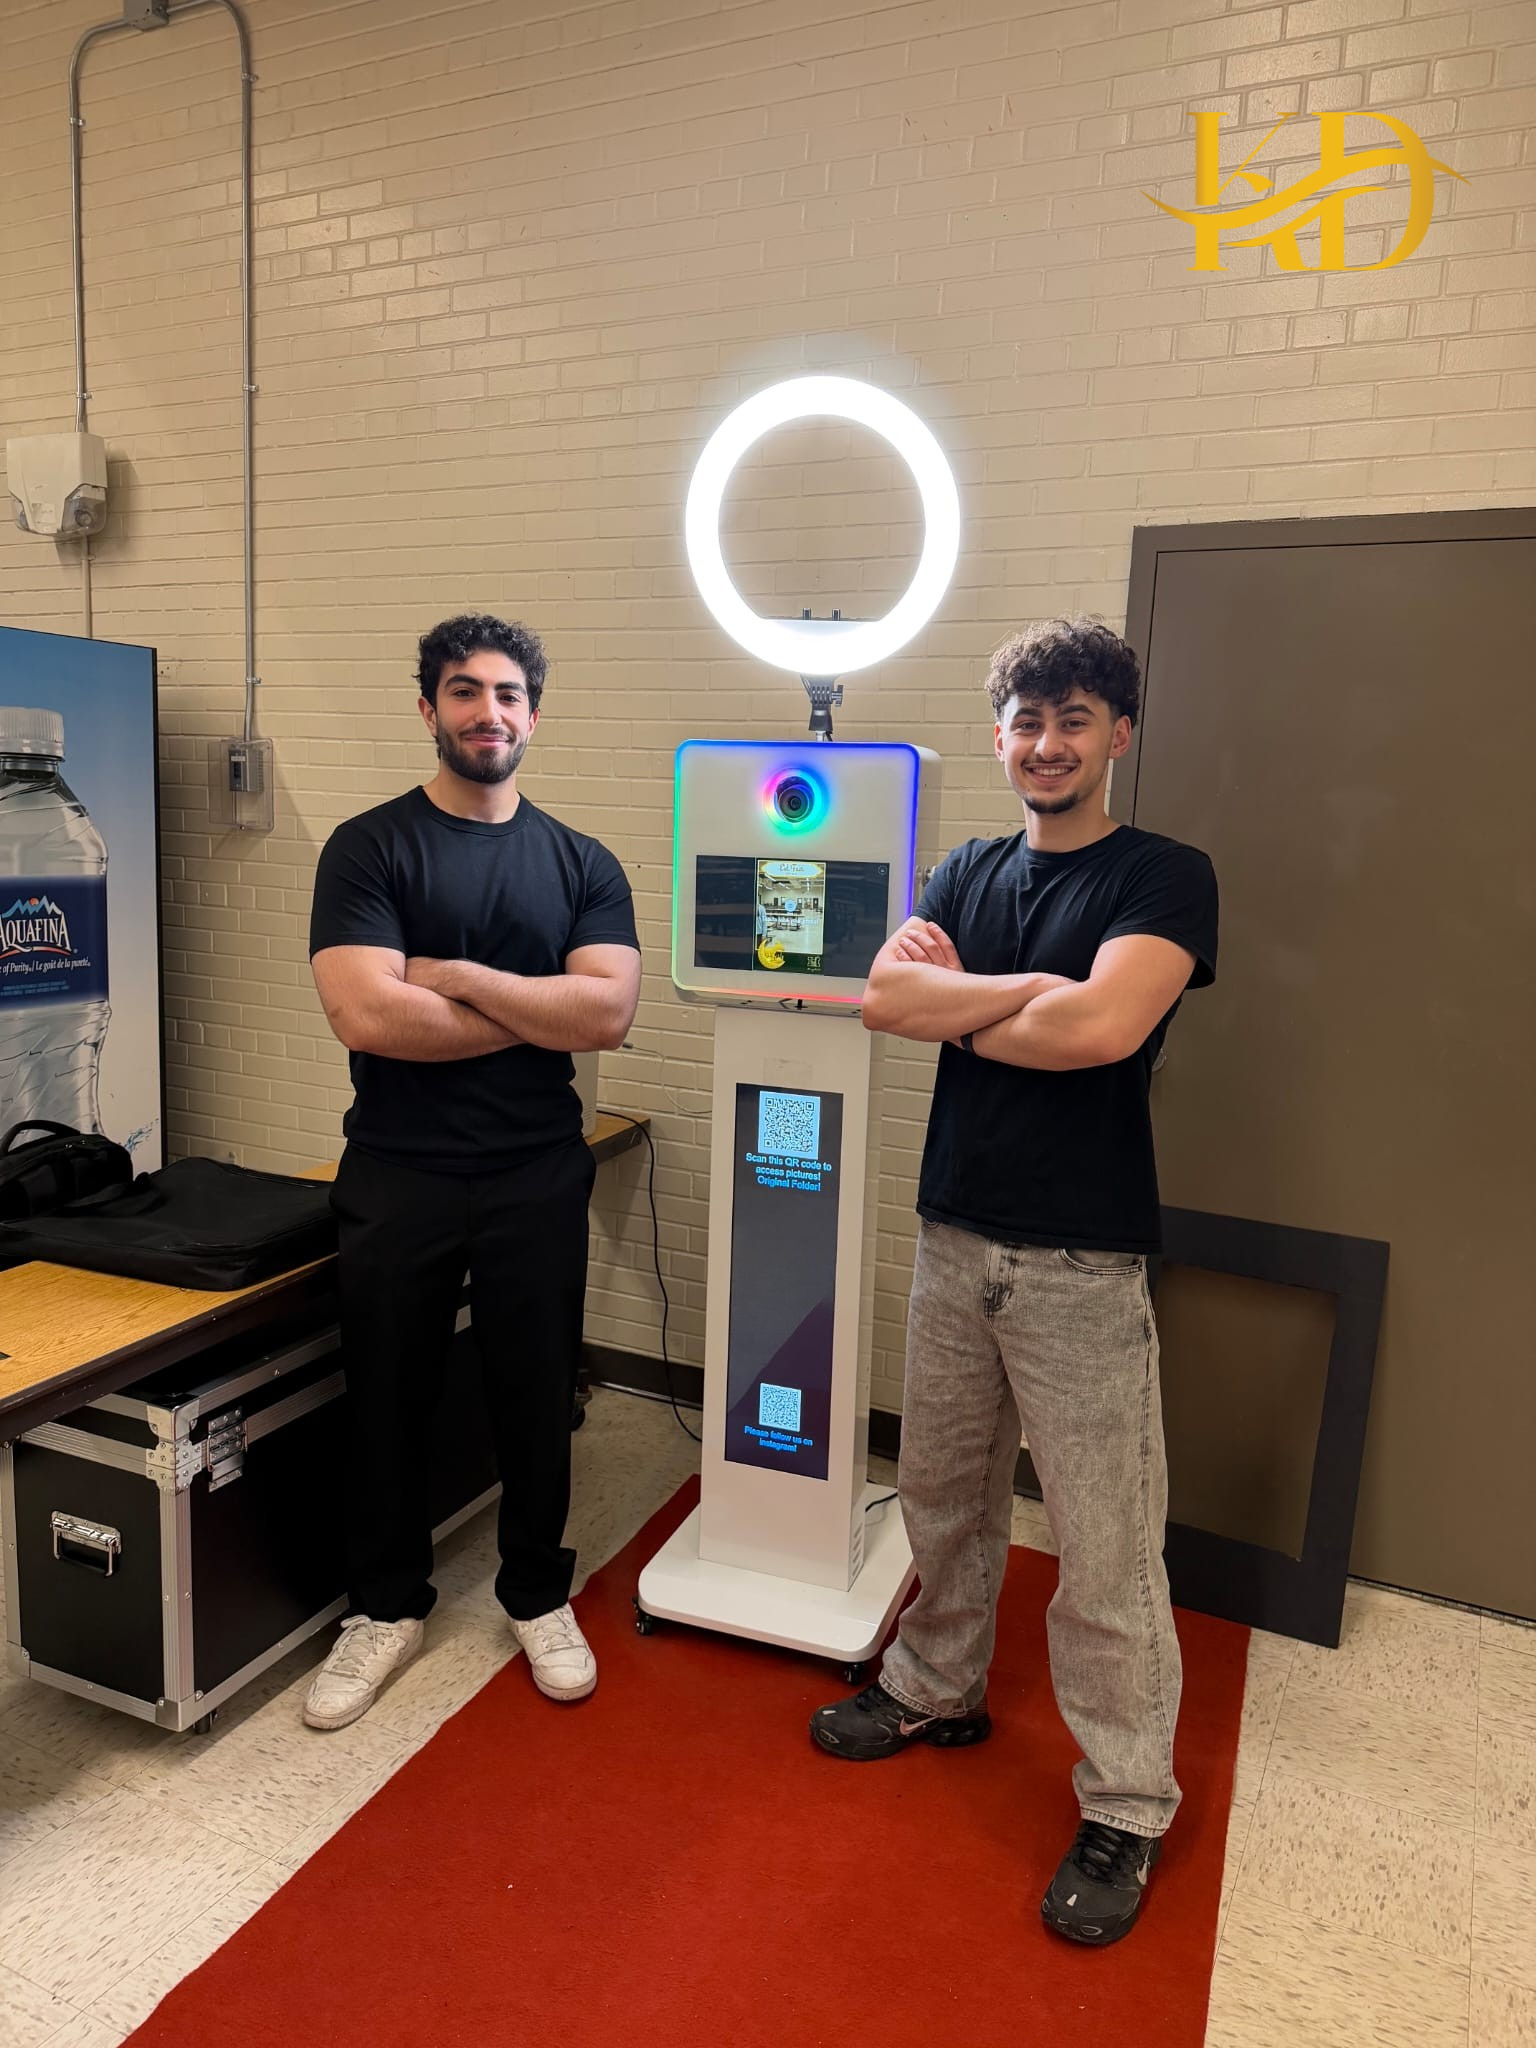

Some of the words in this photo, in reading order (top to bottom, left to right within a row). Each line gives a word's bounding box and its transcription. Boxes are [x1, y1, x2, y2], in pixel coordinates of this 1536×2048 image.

[3, 963, 10, 976] of
[36, 961, 42, 970] Le
[57, 958, 64, 968] de
[64, 957, 70, 968] la
[745, 1152, 767, 1163] Scan
[769, 1155, 783, 1165] this
[785, 1157, 799, 1168] QR
[801, 1160, 821, 1171] code
[823, 1162, 832, 1171] to
[755, 1166, 784, 1176] access
[786, 1169, 820, 1181] pictures!
[757, 1175, 789, 1187] Original
[791, 1179, 821, 1191] Folder!
[744, 1425, 769, 1438] Please
[770, 1430, 792, 1442] follow
[793, 1436, 802, 1444] us
[803, 1438, 813, 1446] on
